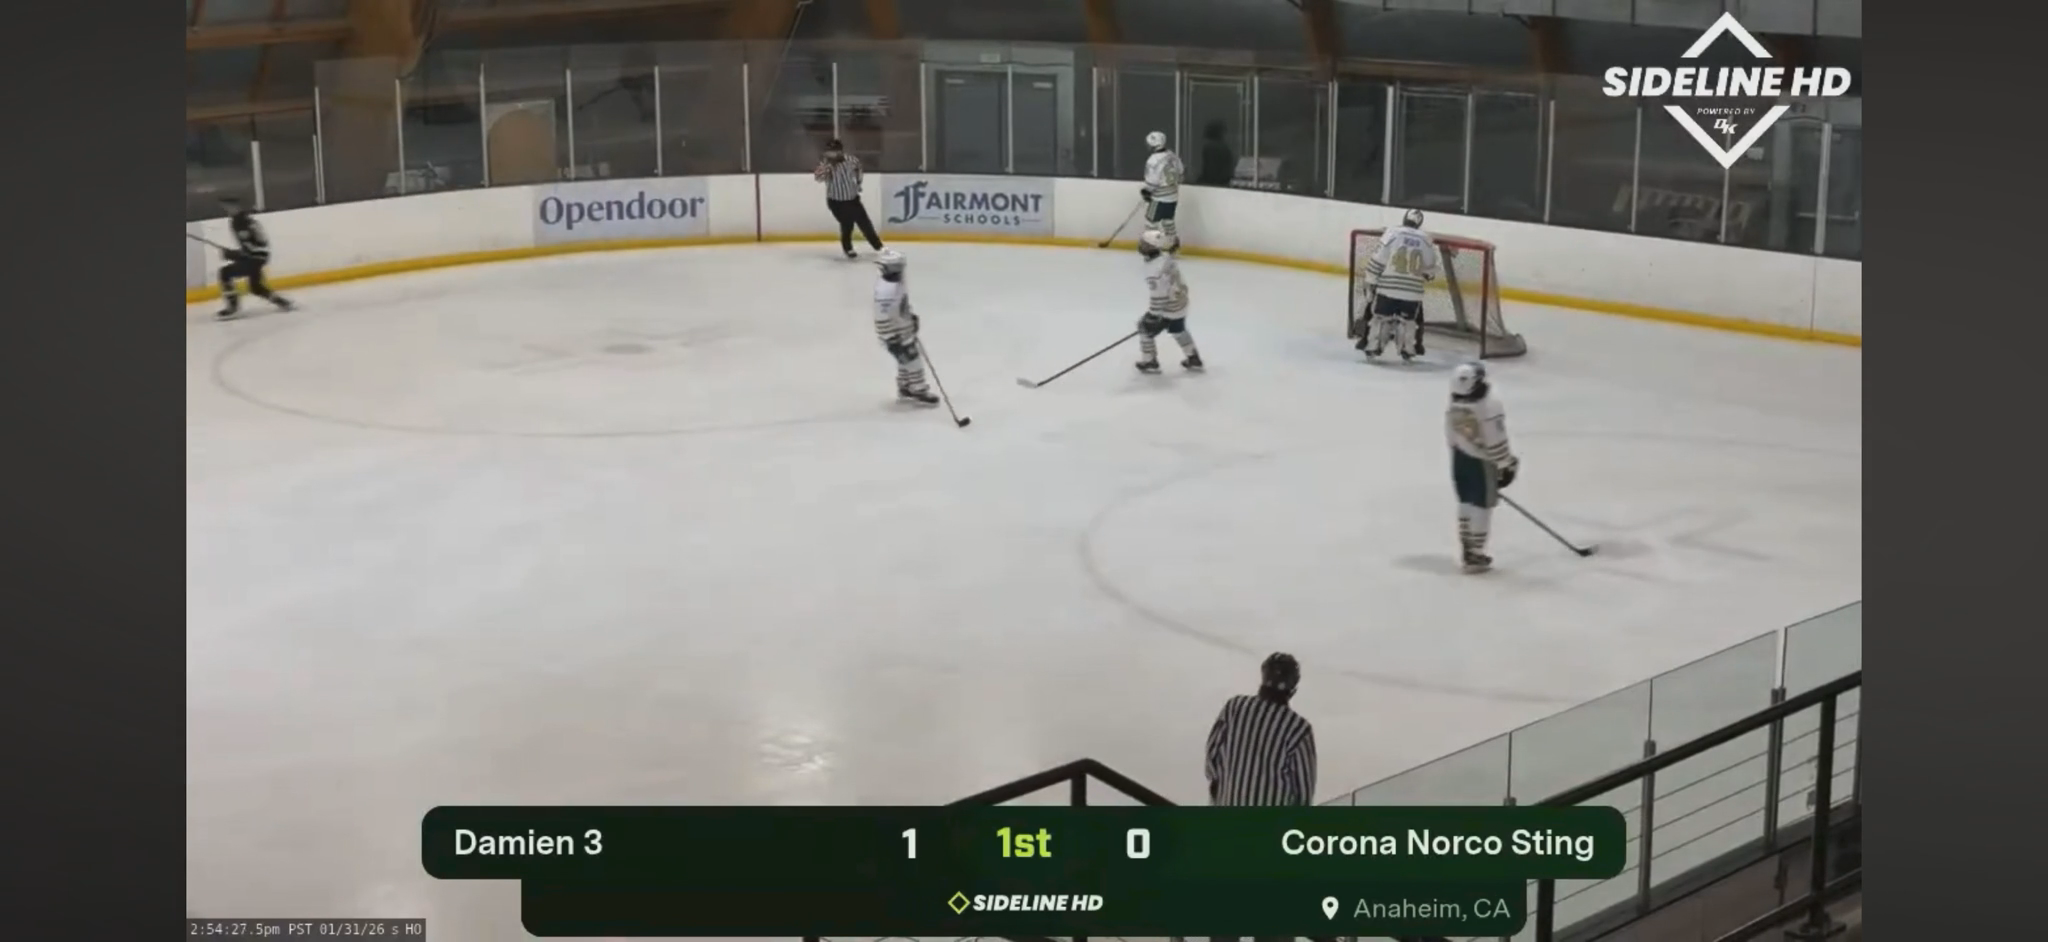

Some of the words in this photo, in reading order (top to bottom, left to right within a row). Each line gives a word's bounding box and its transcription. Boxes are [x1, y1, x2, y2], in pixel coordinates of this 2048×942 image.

[539, 190, 705, 230] Opendoor
[888, 180, 1043, 224] FAIRMONT
[943, 213, 1021, 226] SCHOOLS
[1392, 245, 1424, 276] 40
